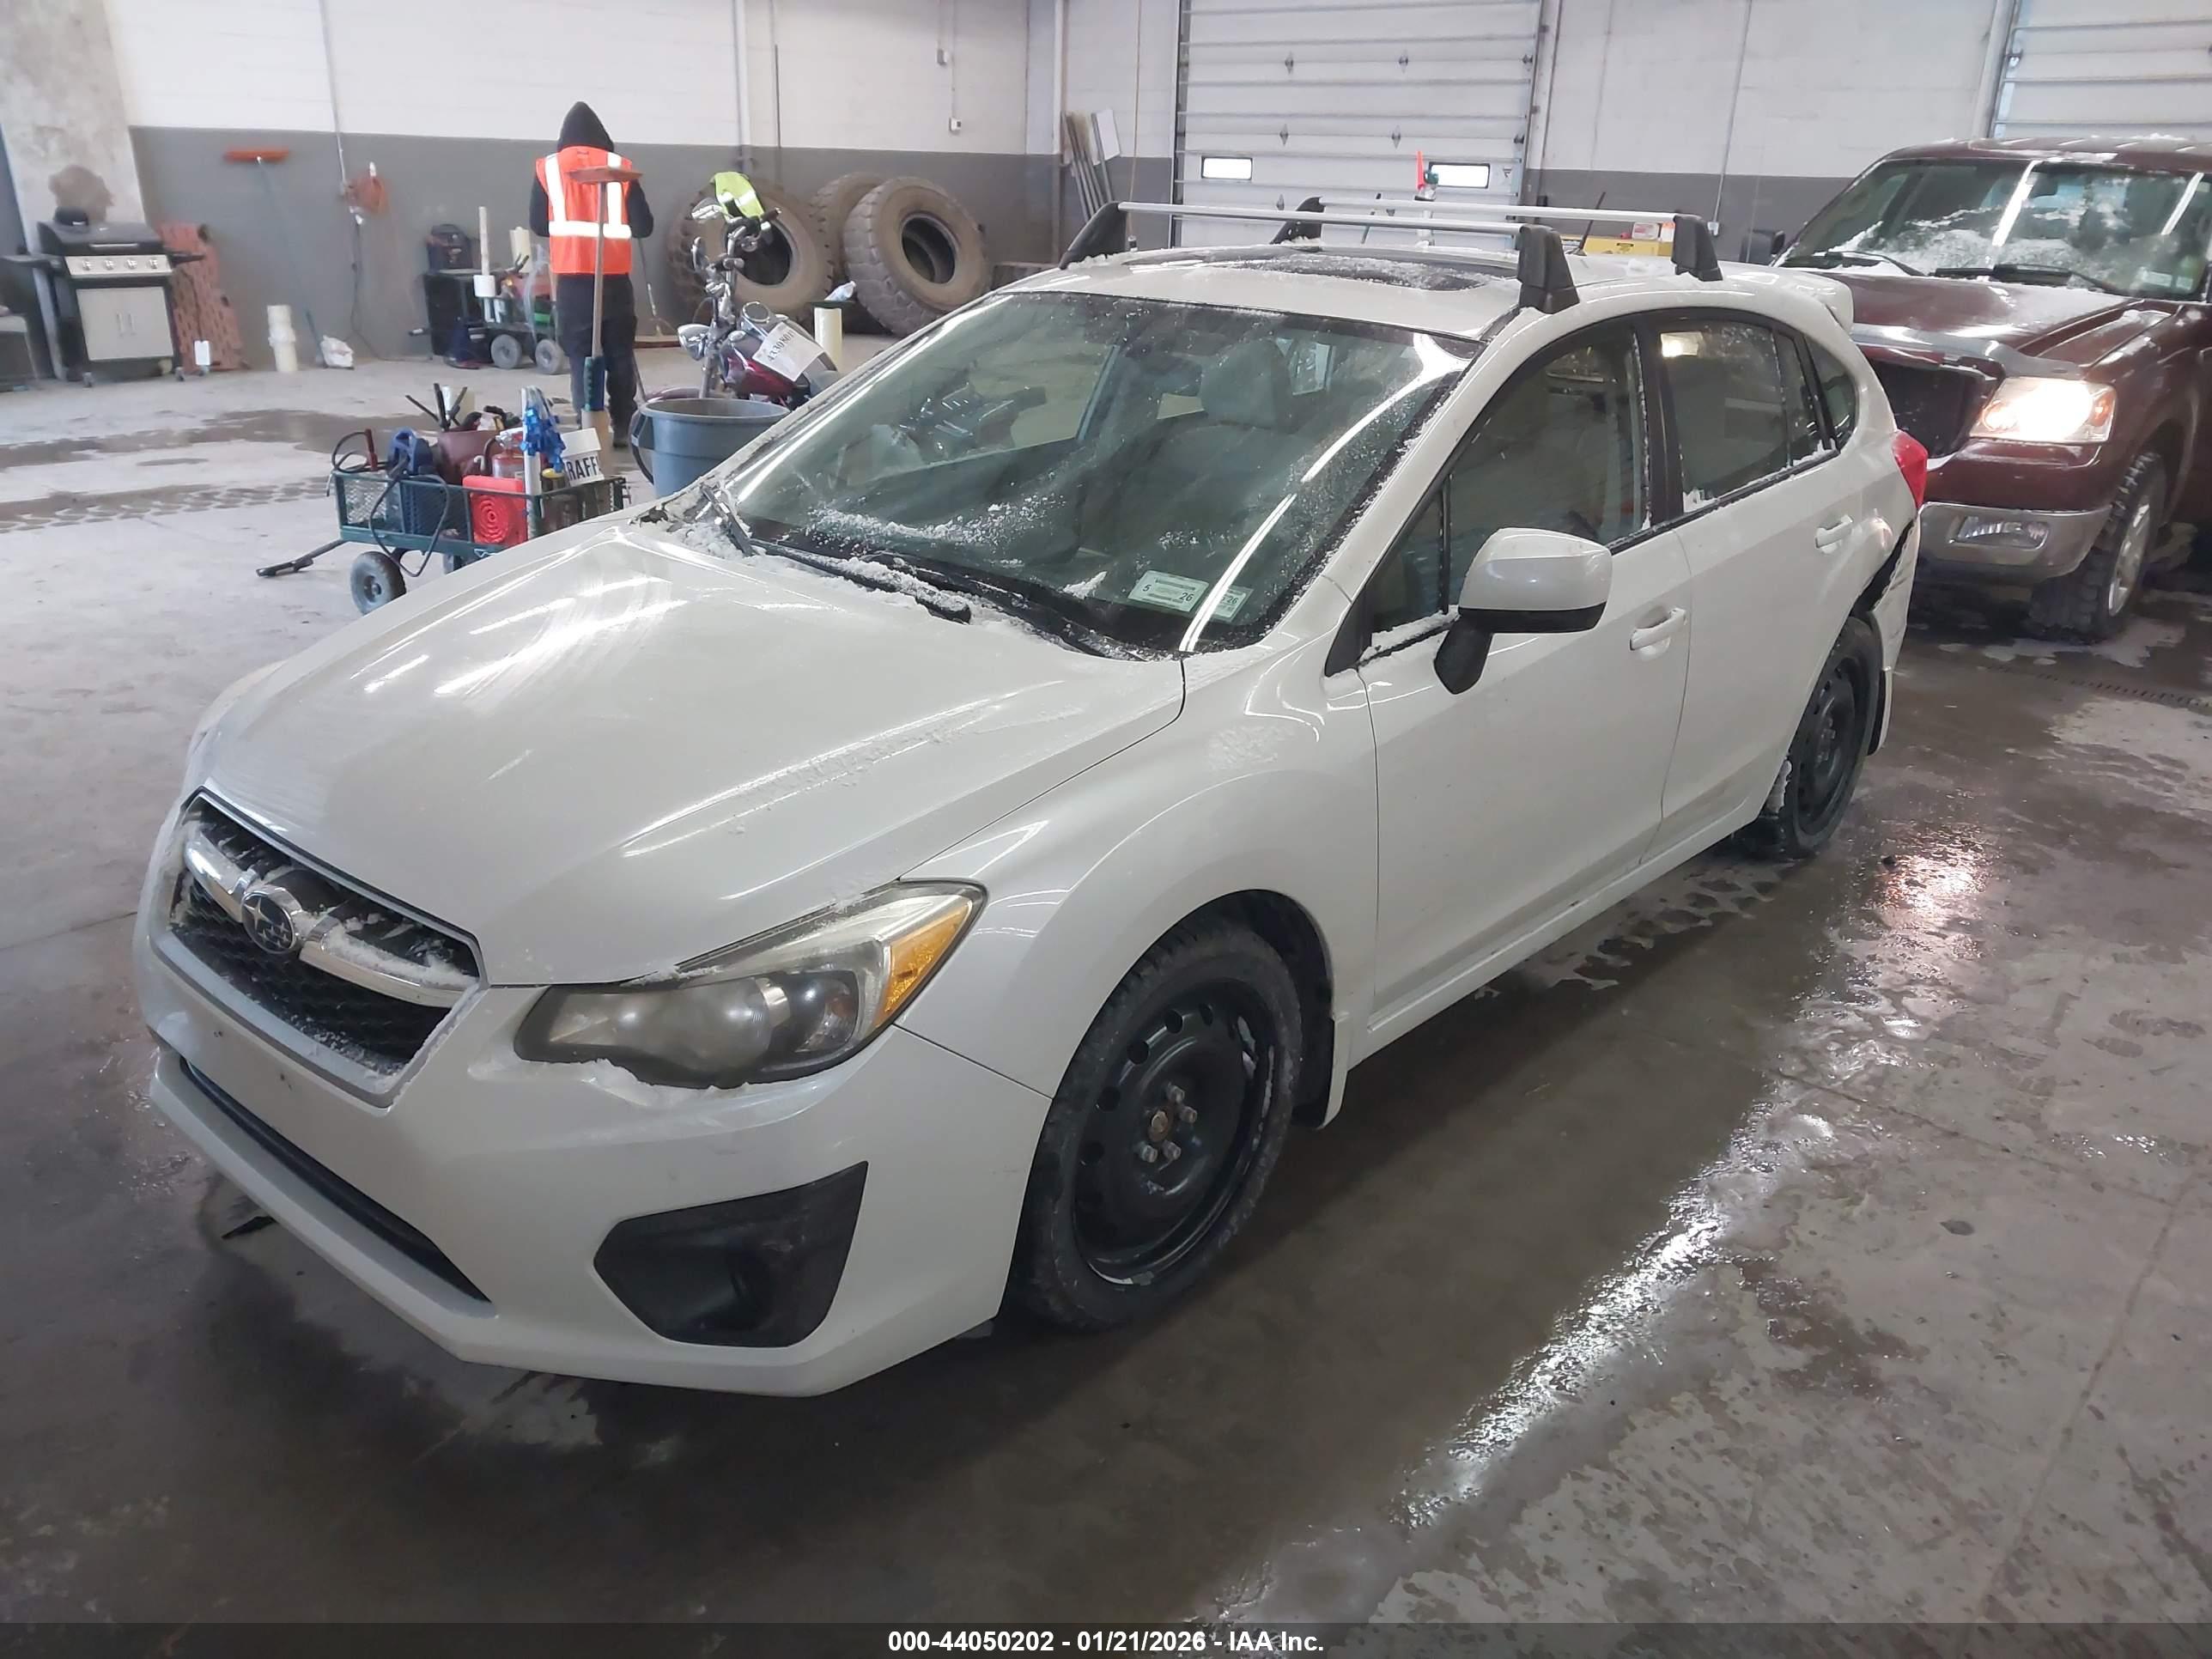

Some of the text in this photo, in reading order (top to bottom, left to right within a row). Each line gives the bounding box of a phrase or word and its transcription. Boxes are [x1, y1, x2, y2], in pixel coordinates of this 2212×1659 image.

[564, 456, 599, 481] RAFF
[1142, 584, 1152, 592] 5
[1179, 592, 1194, 602] 26
